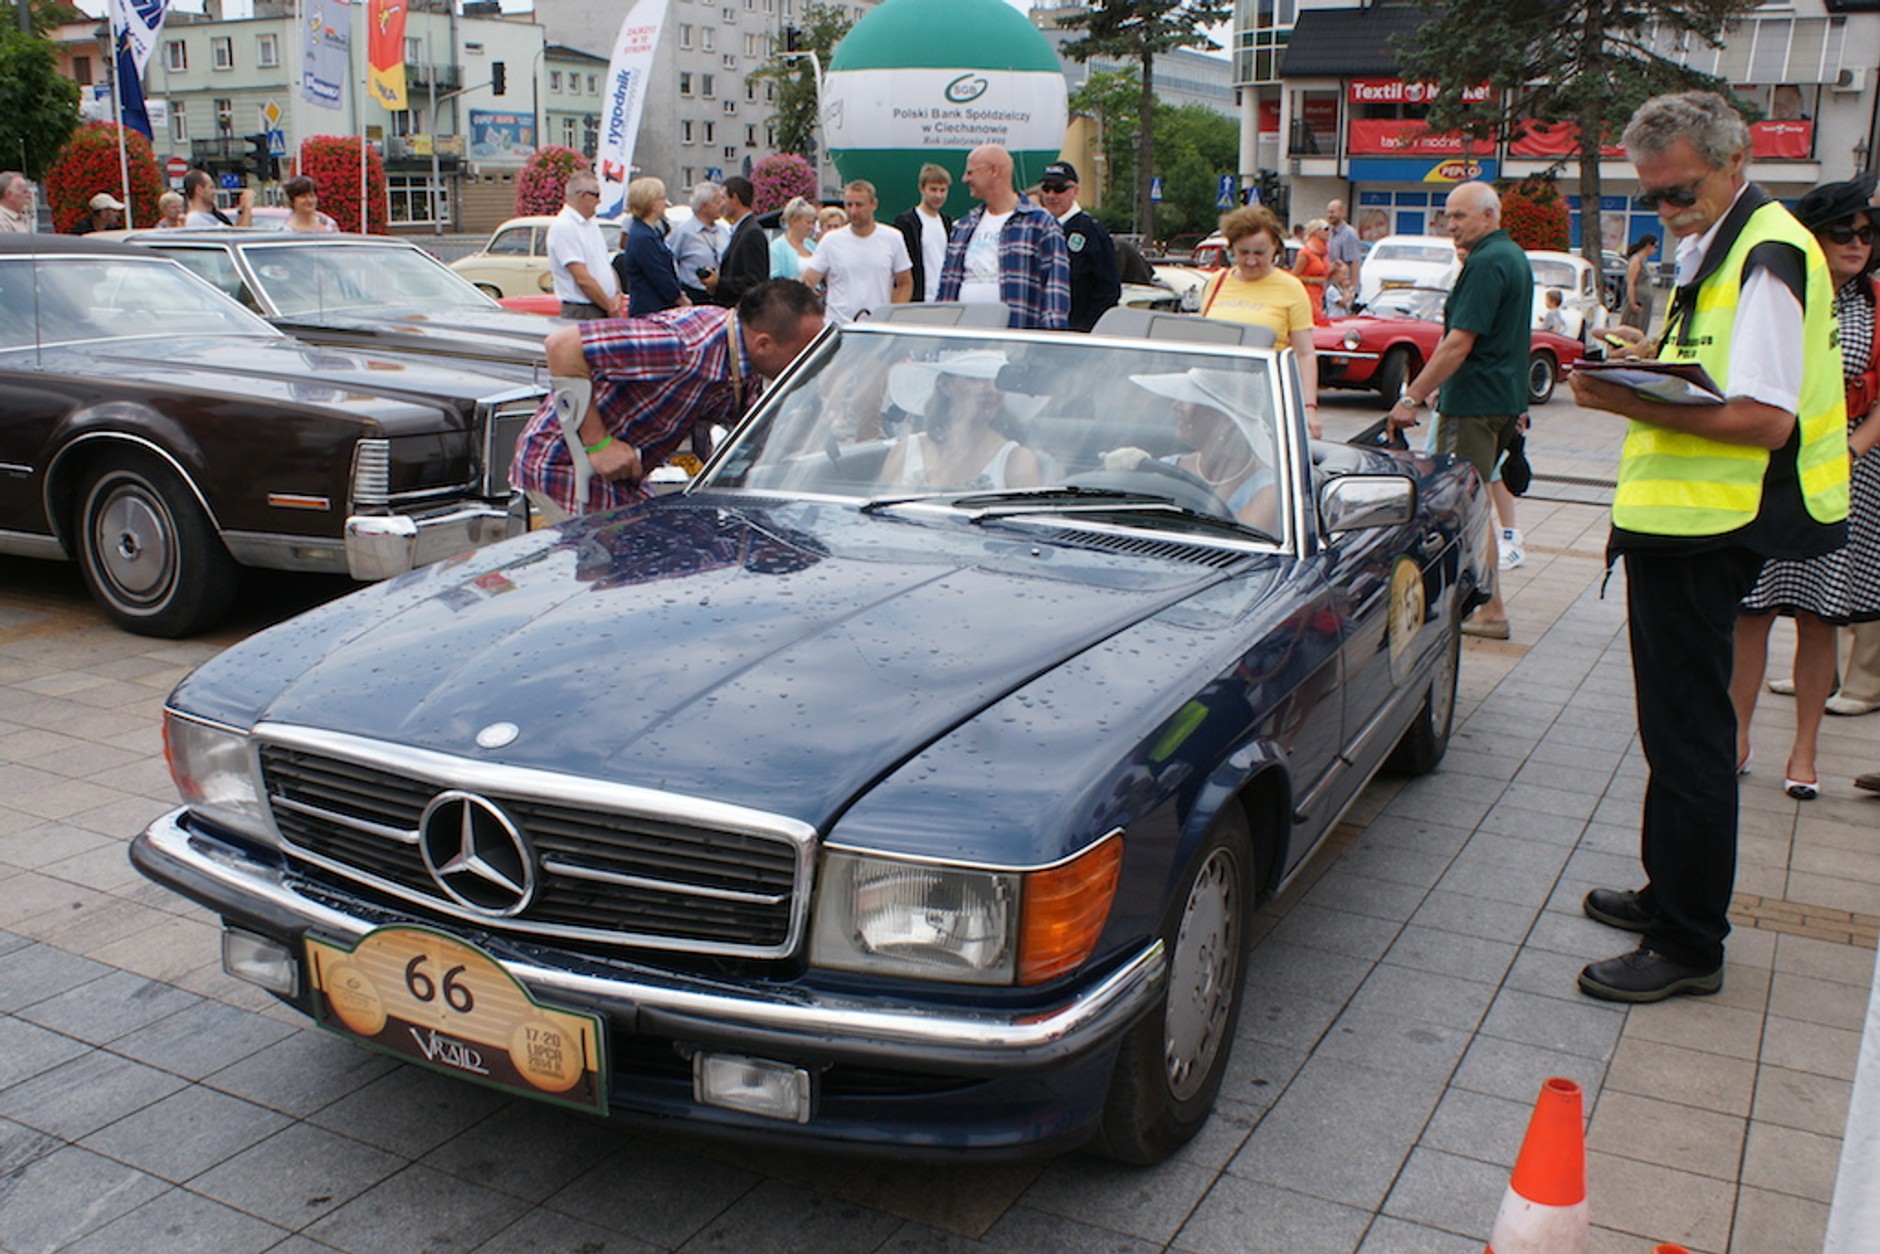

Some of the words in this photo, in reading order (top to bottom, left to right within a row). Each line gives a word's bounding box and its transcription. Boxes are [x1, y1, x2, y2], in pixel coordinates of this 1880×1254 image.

[1353, 83, 1402, 99] Textil
[893, 108, 928, 119] Polski
[931, 108, 962, 119] Bank
[966, 109, 1031, 122] Spółdzielczy
[935, 122, 1008, 134] Ciechanowie
[405, 954, 474, 1013] 66
